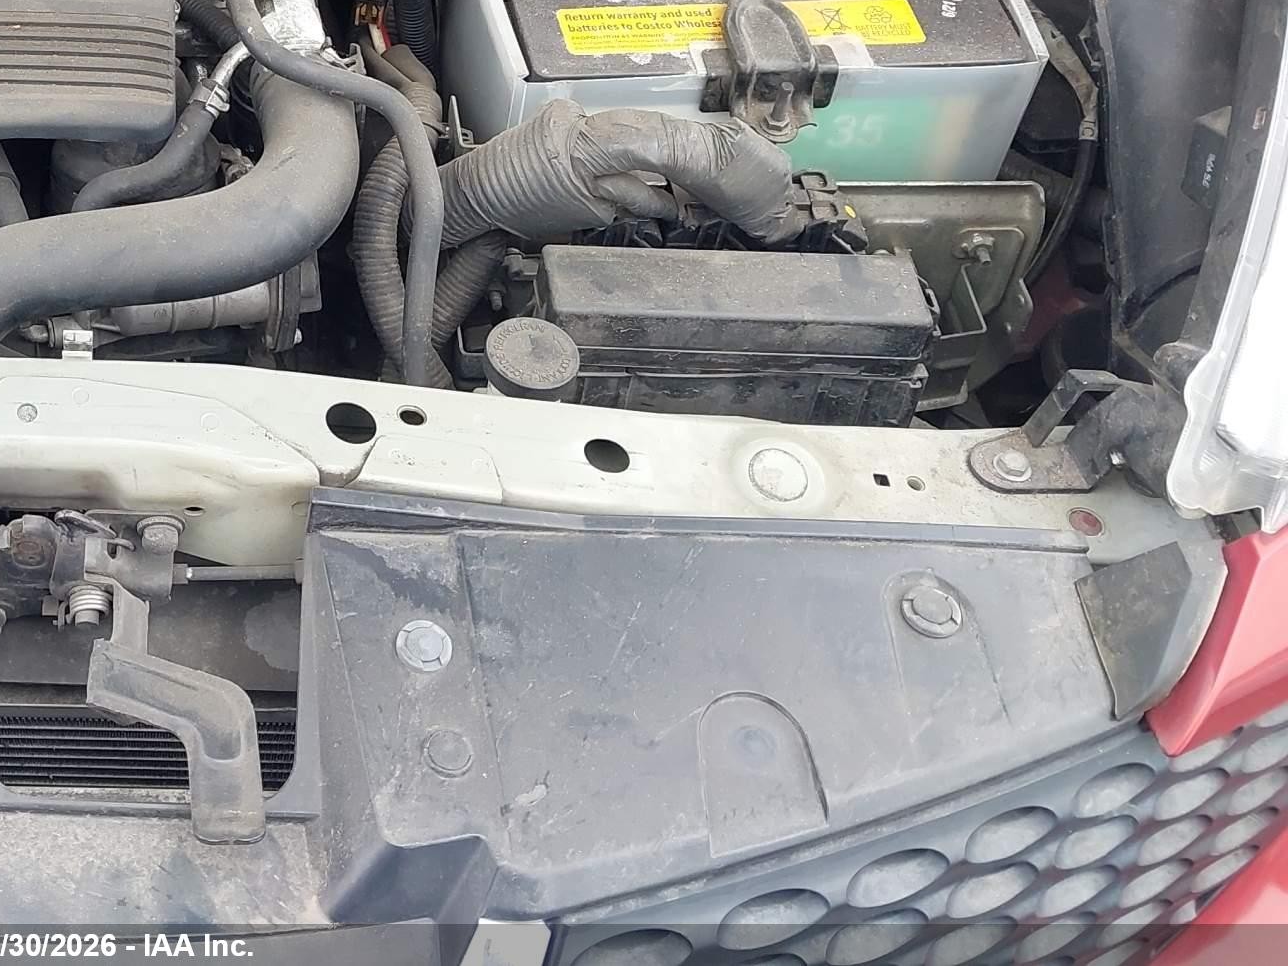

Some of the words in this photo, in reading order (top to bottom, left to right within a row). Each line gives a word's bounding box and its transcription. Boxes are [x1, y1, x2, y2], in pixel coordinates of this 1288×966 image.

[564, 13, 604, 21] Return
[606, 11, 657, 21] warranty
[660, 9, 683, 18] and
[685, 8, 712, 17] used
[567, 23, 619, 32] batteries
[621, 23, 632, 31] to
[635, 21, 672, 30] Costco
